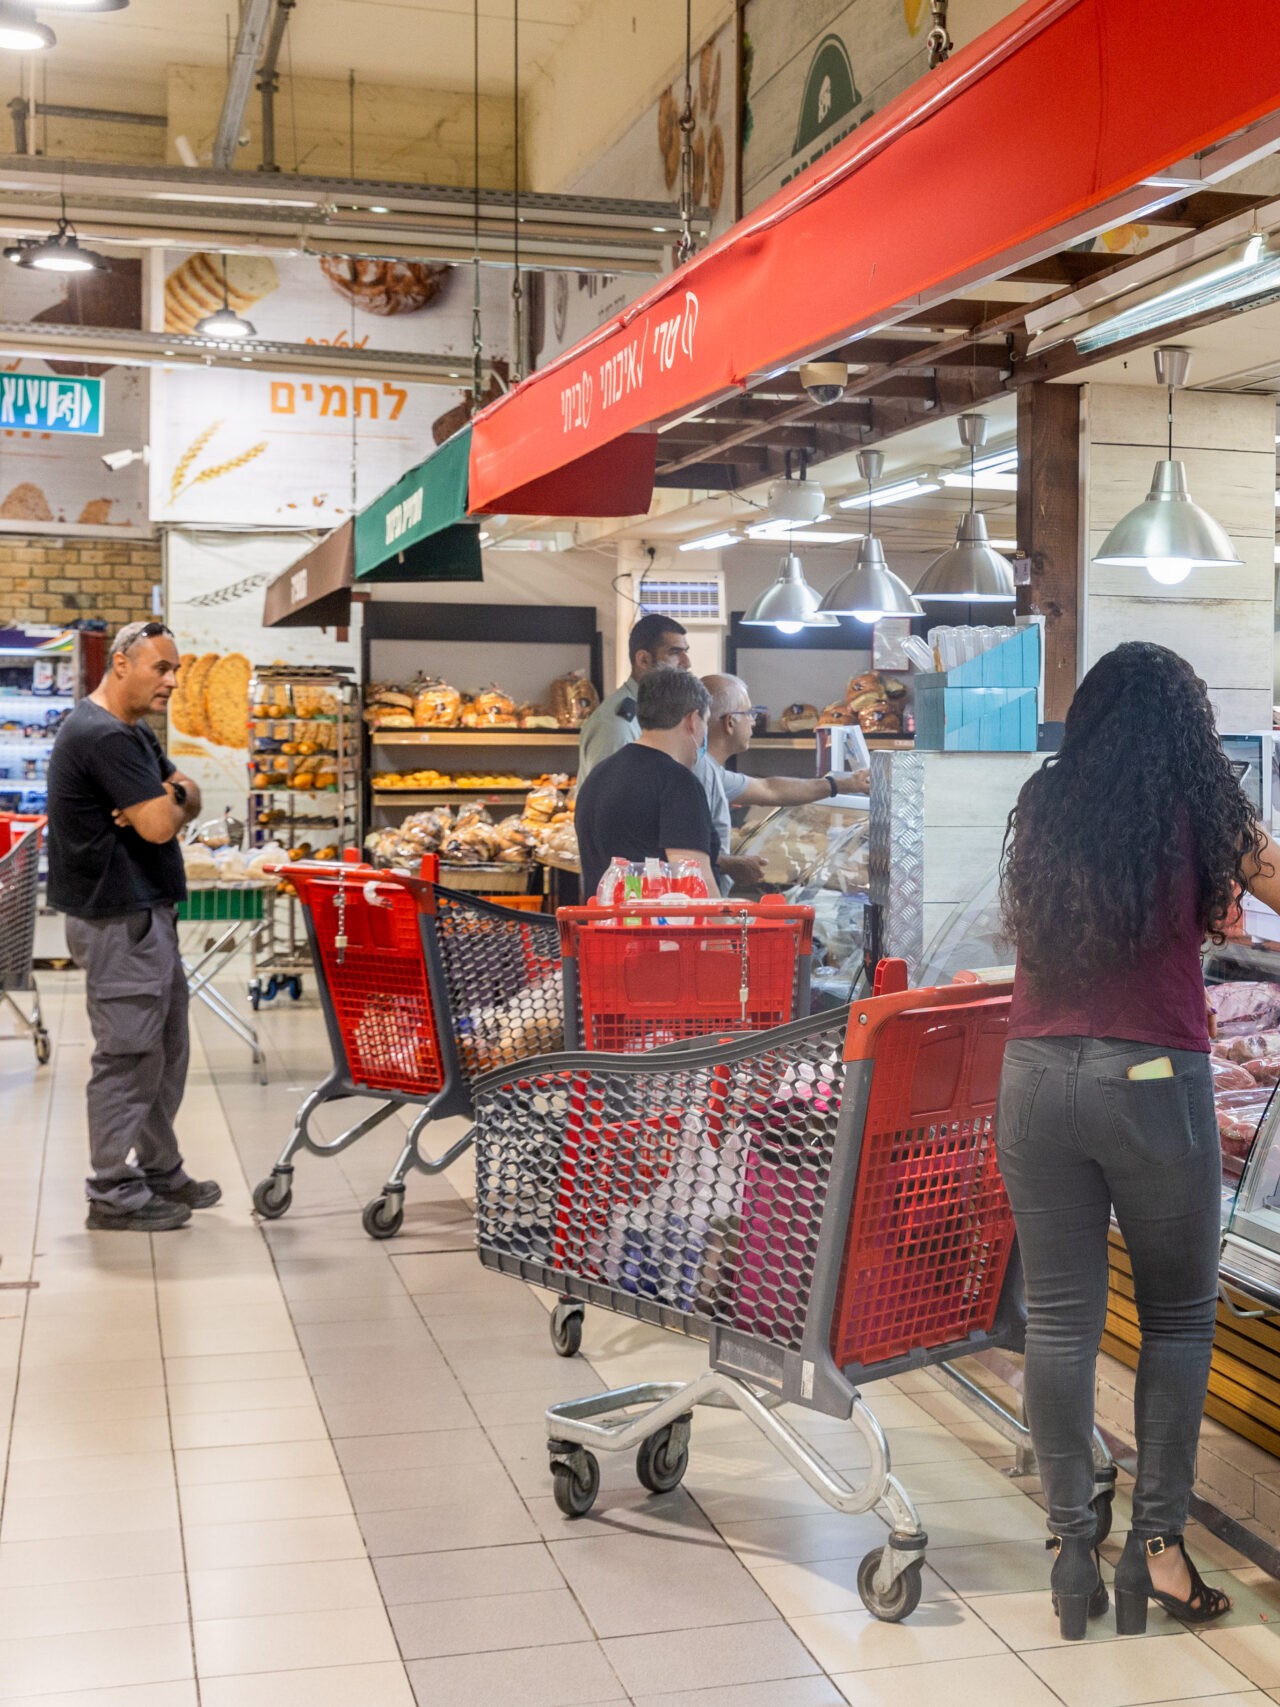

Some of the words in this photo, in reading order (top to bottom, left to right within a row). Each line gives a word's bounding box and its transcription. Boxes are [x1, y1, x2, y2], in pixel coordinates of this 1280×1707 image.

[653, 314, 681, 373] טרי
[1, 377, 47, 425] יציא
[271, 381, 408, 420] לחמים
